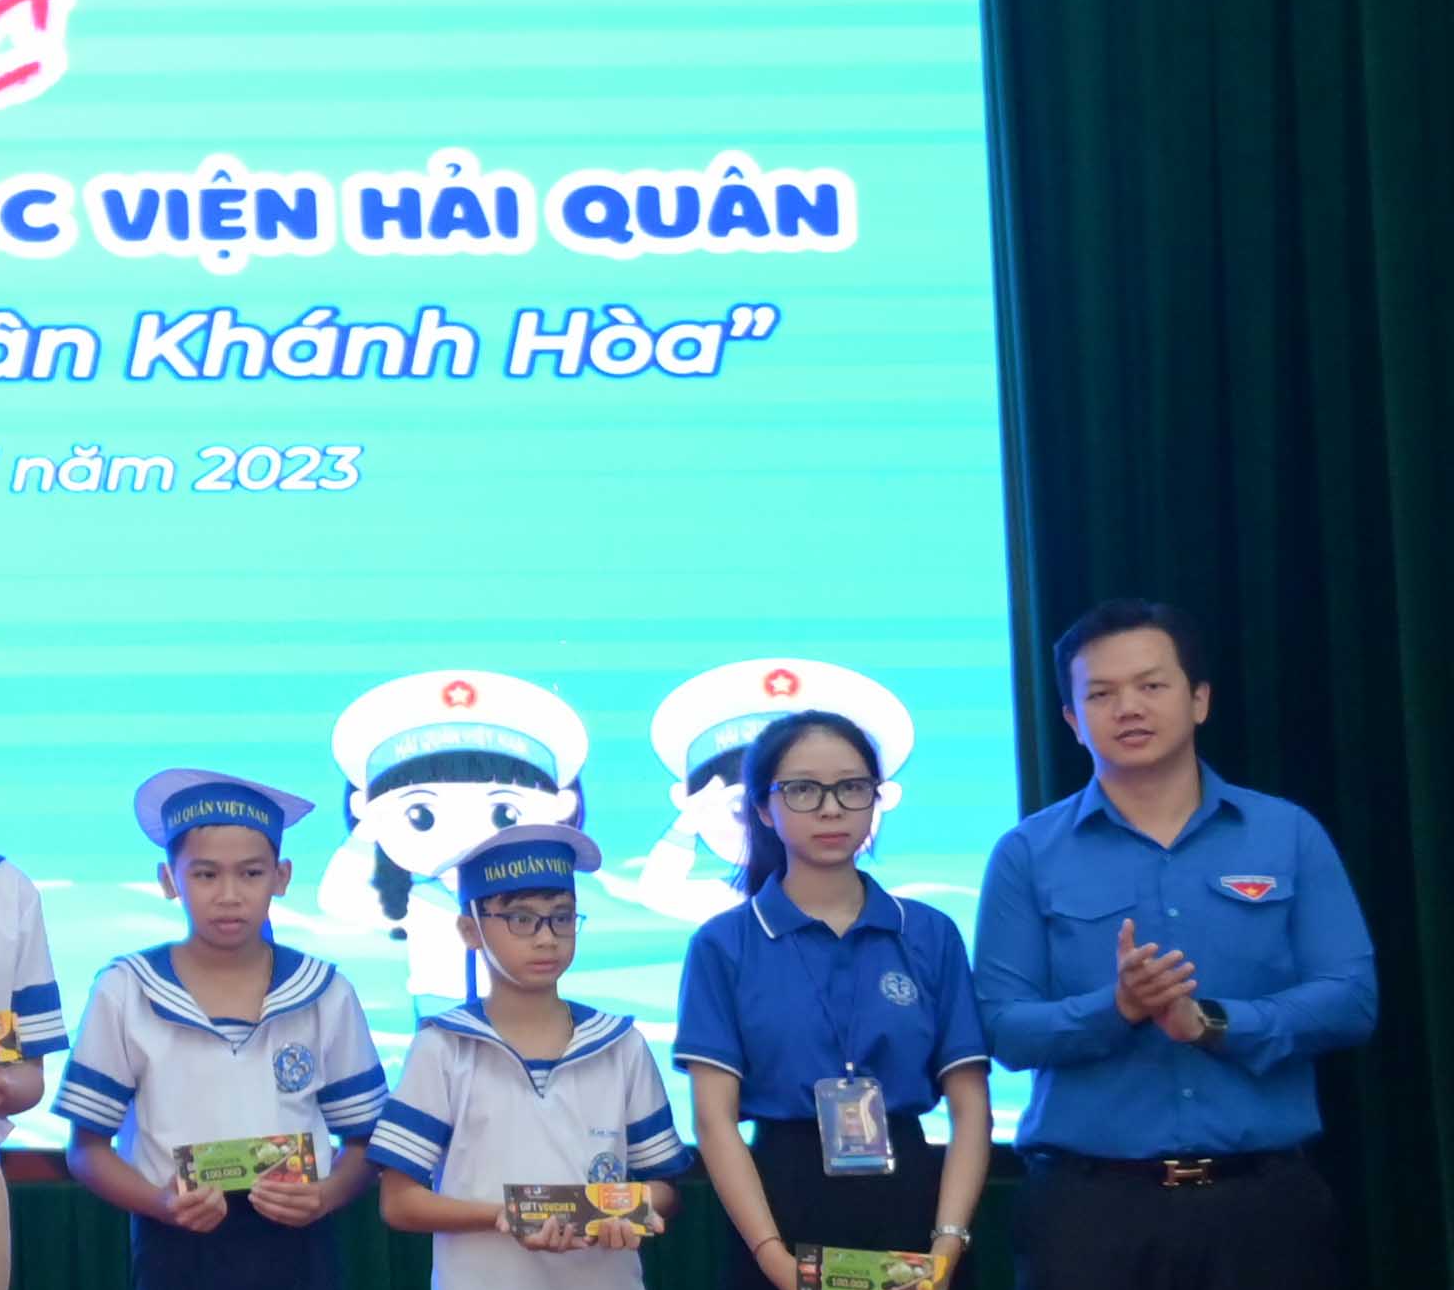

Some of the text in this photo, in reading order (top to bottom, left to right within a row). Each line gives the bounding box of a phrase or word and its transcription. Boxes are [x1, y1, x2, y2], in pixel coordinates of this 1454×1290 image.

[99, 170, 320, 262] VIỆN
[358, 162, 522, 241] HẢI
[560, 165, 842, 245] QUÂN
[127, 305, 481, 382] Khánh
[505, 303, 782, 380] Hòa”
[9, 443, 176, 494] năm
[192, 442, 365, 493] 2023
[216, 799, 245, 818] VIỆT
[507, 855, 544, 880] QUÂN
